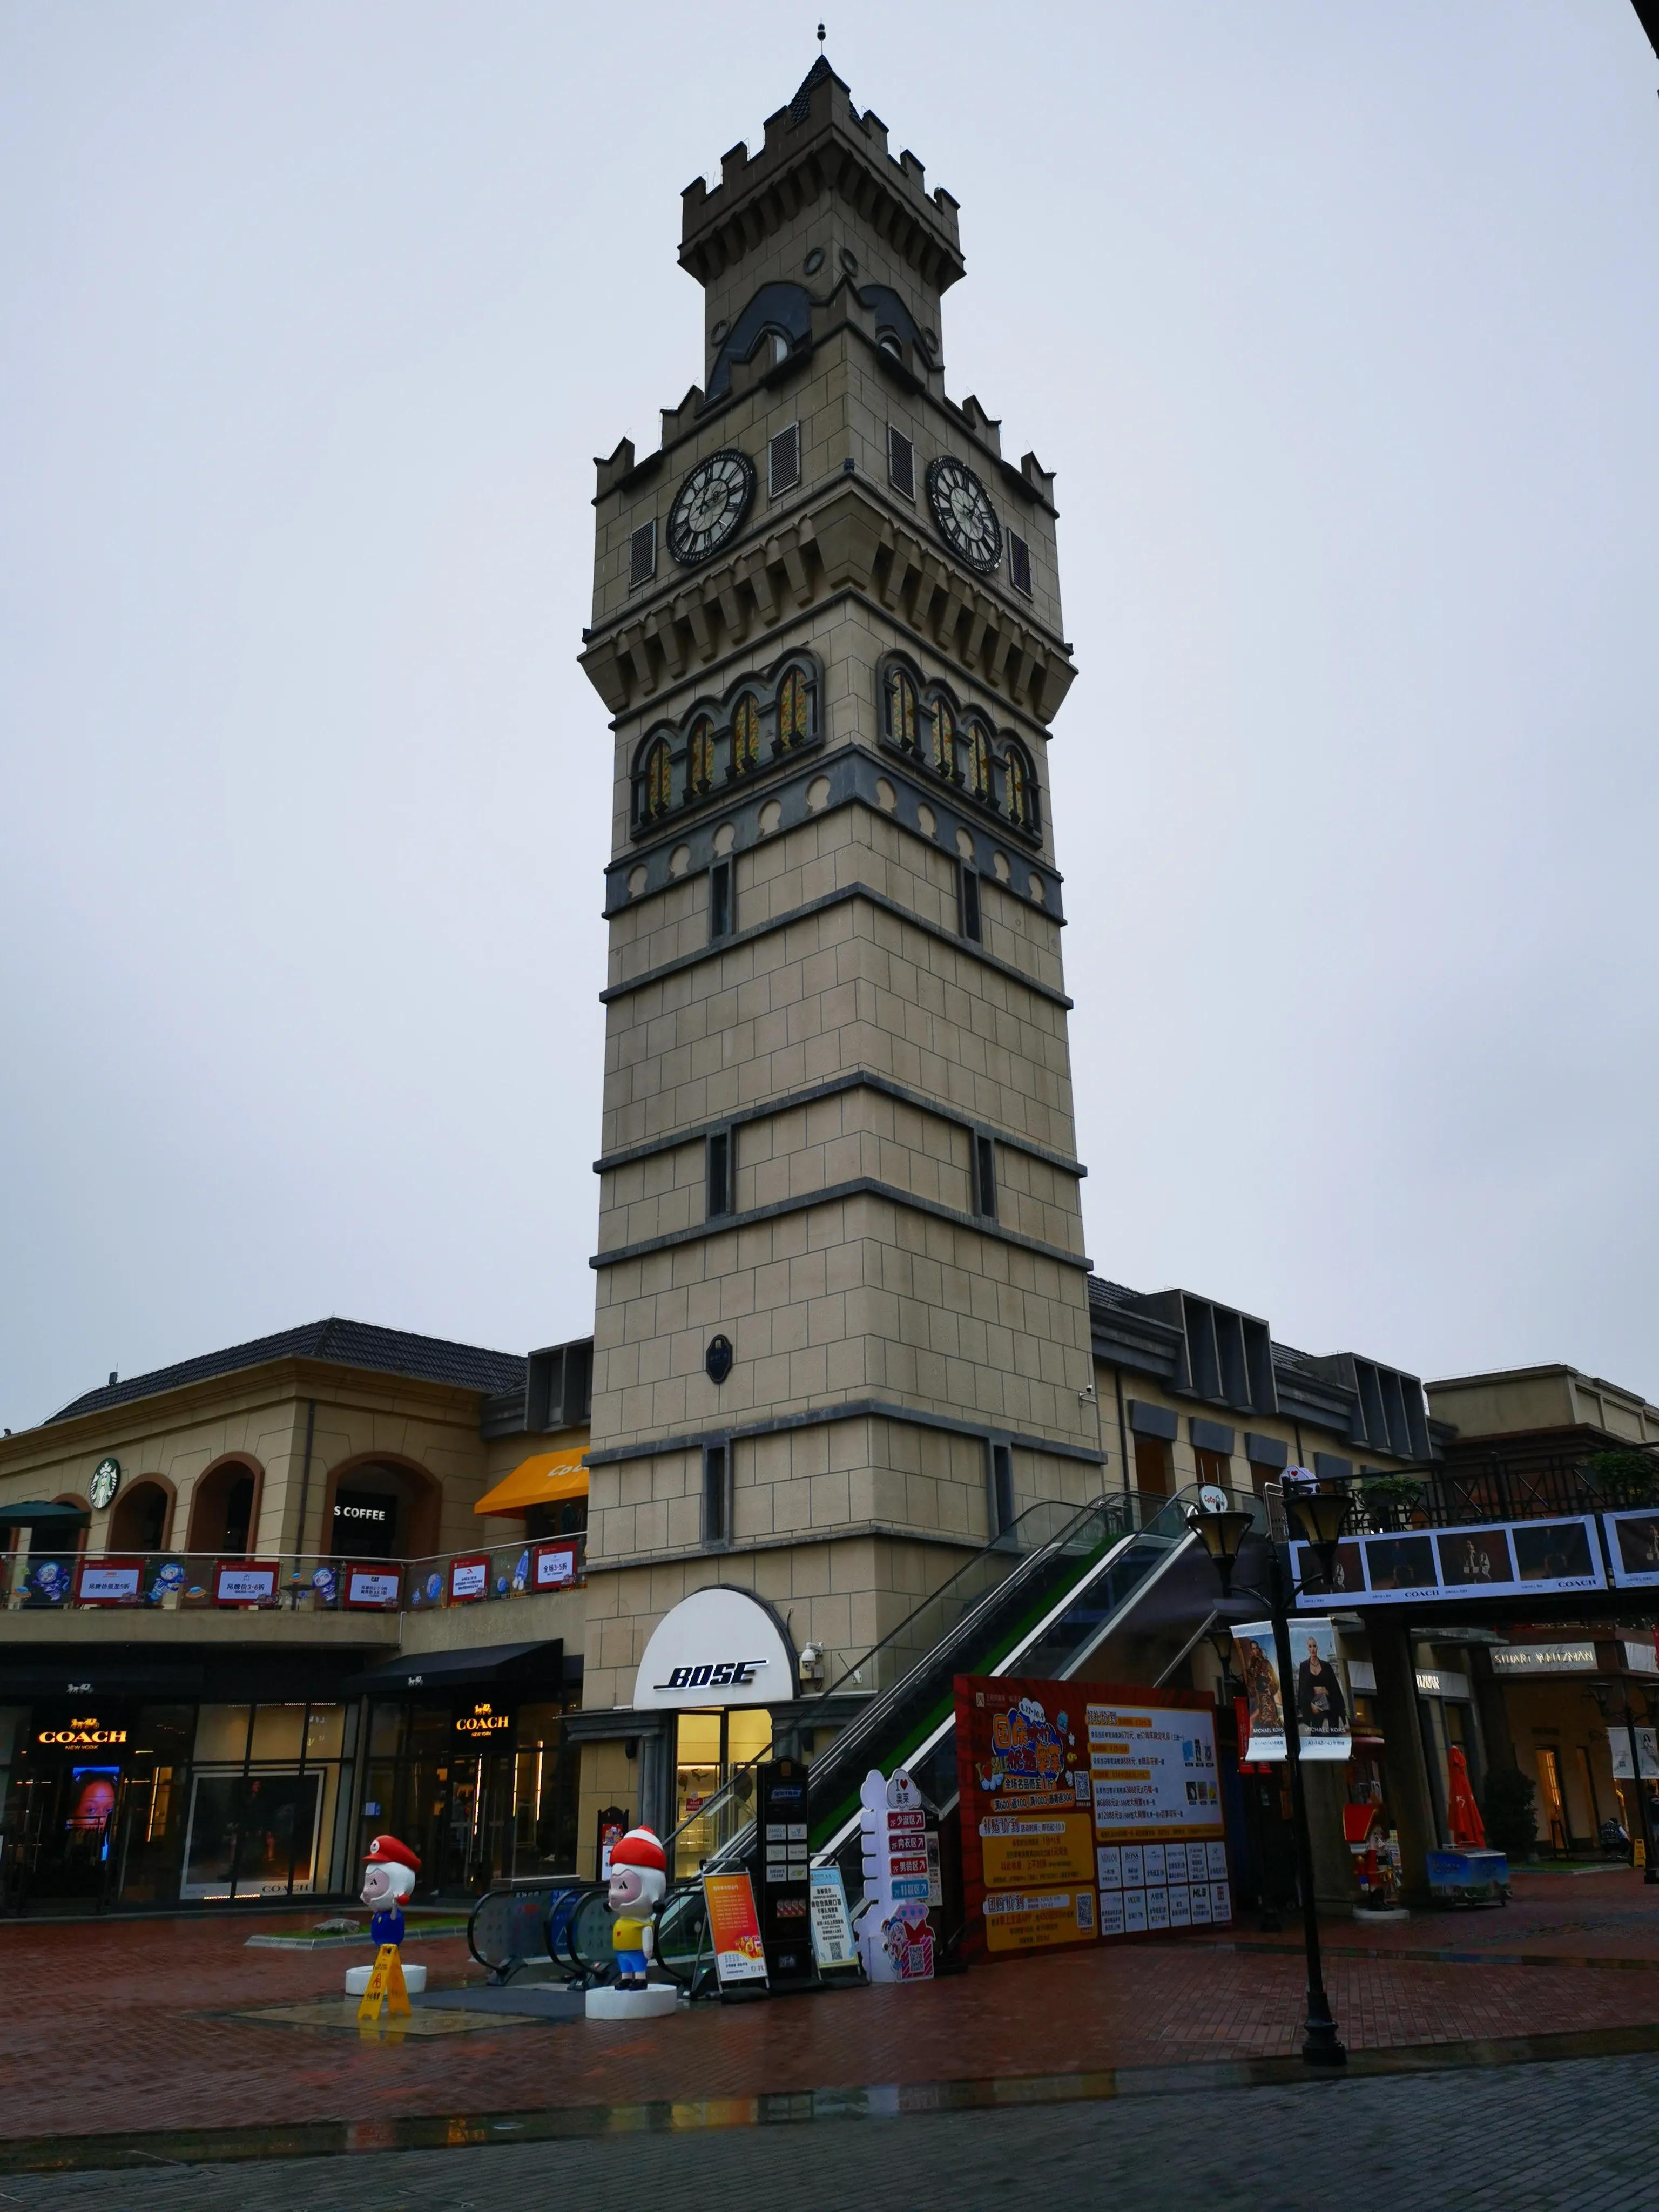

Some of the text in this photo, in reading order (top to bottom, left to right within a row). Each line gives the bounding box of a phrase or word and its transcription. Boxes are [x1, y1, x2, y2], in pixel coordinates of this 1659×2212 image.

[343, 1506, 386, 1521] COFFEE
[1558, 1580, 1596, 1588] COACH
[653, 1660, 767, 1690] BOSE
[456, 1715, 509, 1731] COACH
[38, 1730, 128, 1743] COACH
[896, 1793, 909, 1804] 奥莱
[1192, 1887, 1207, 1898] MLB
